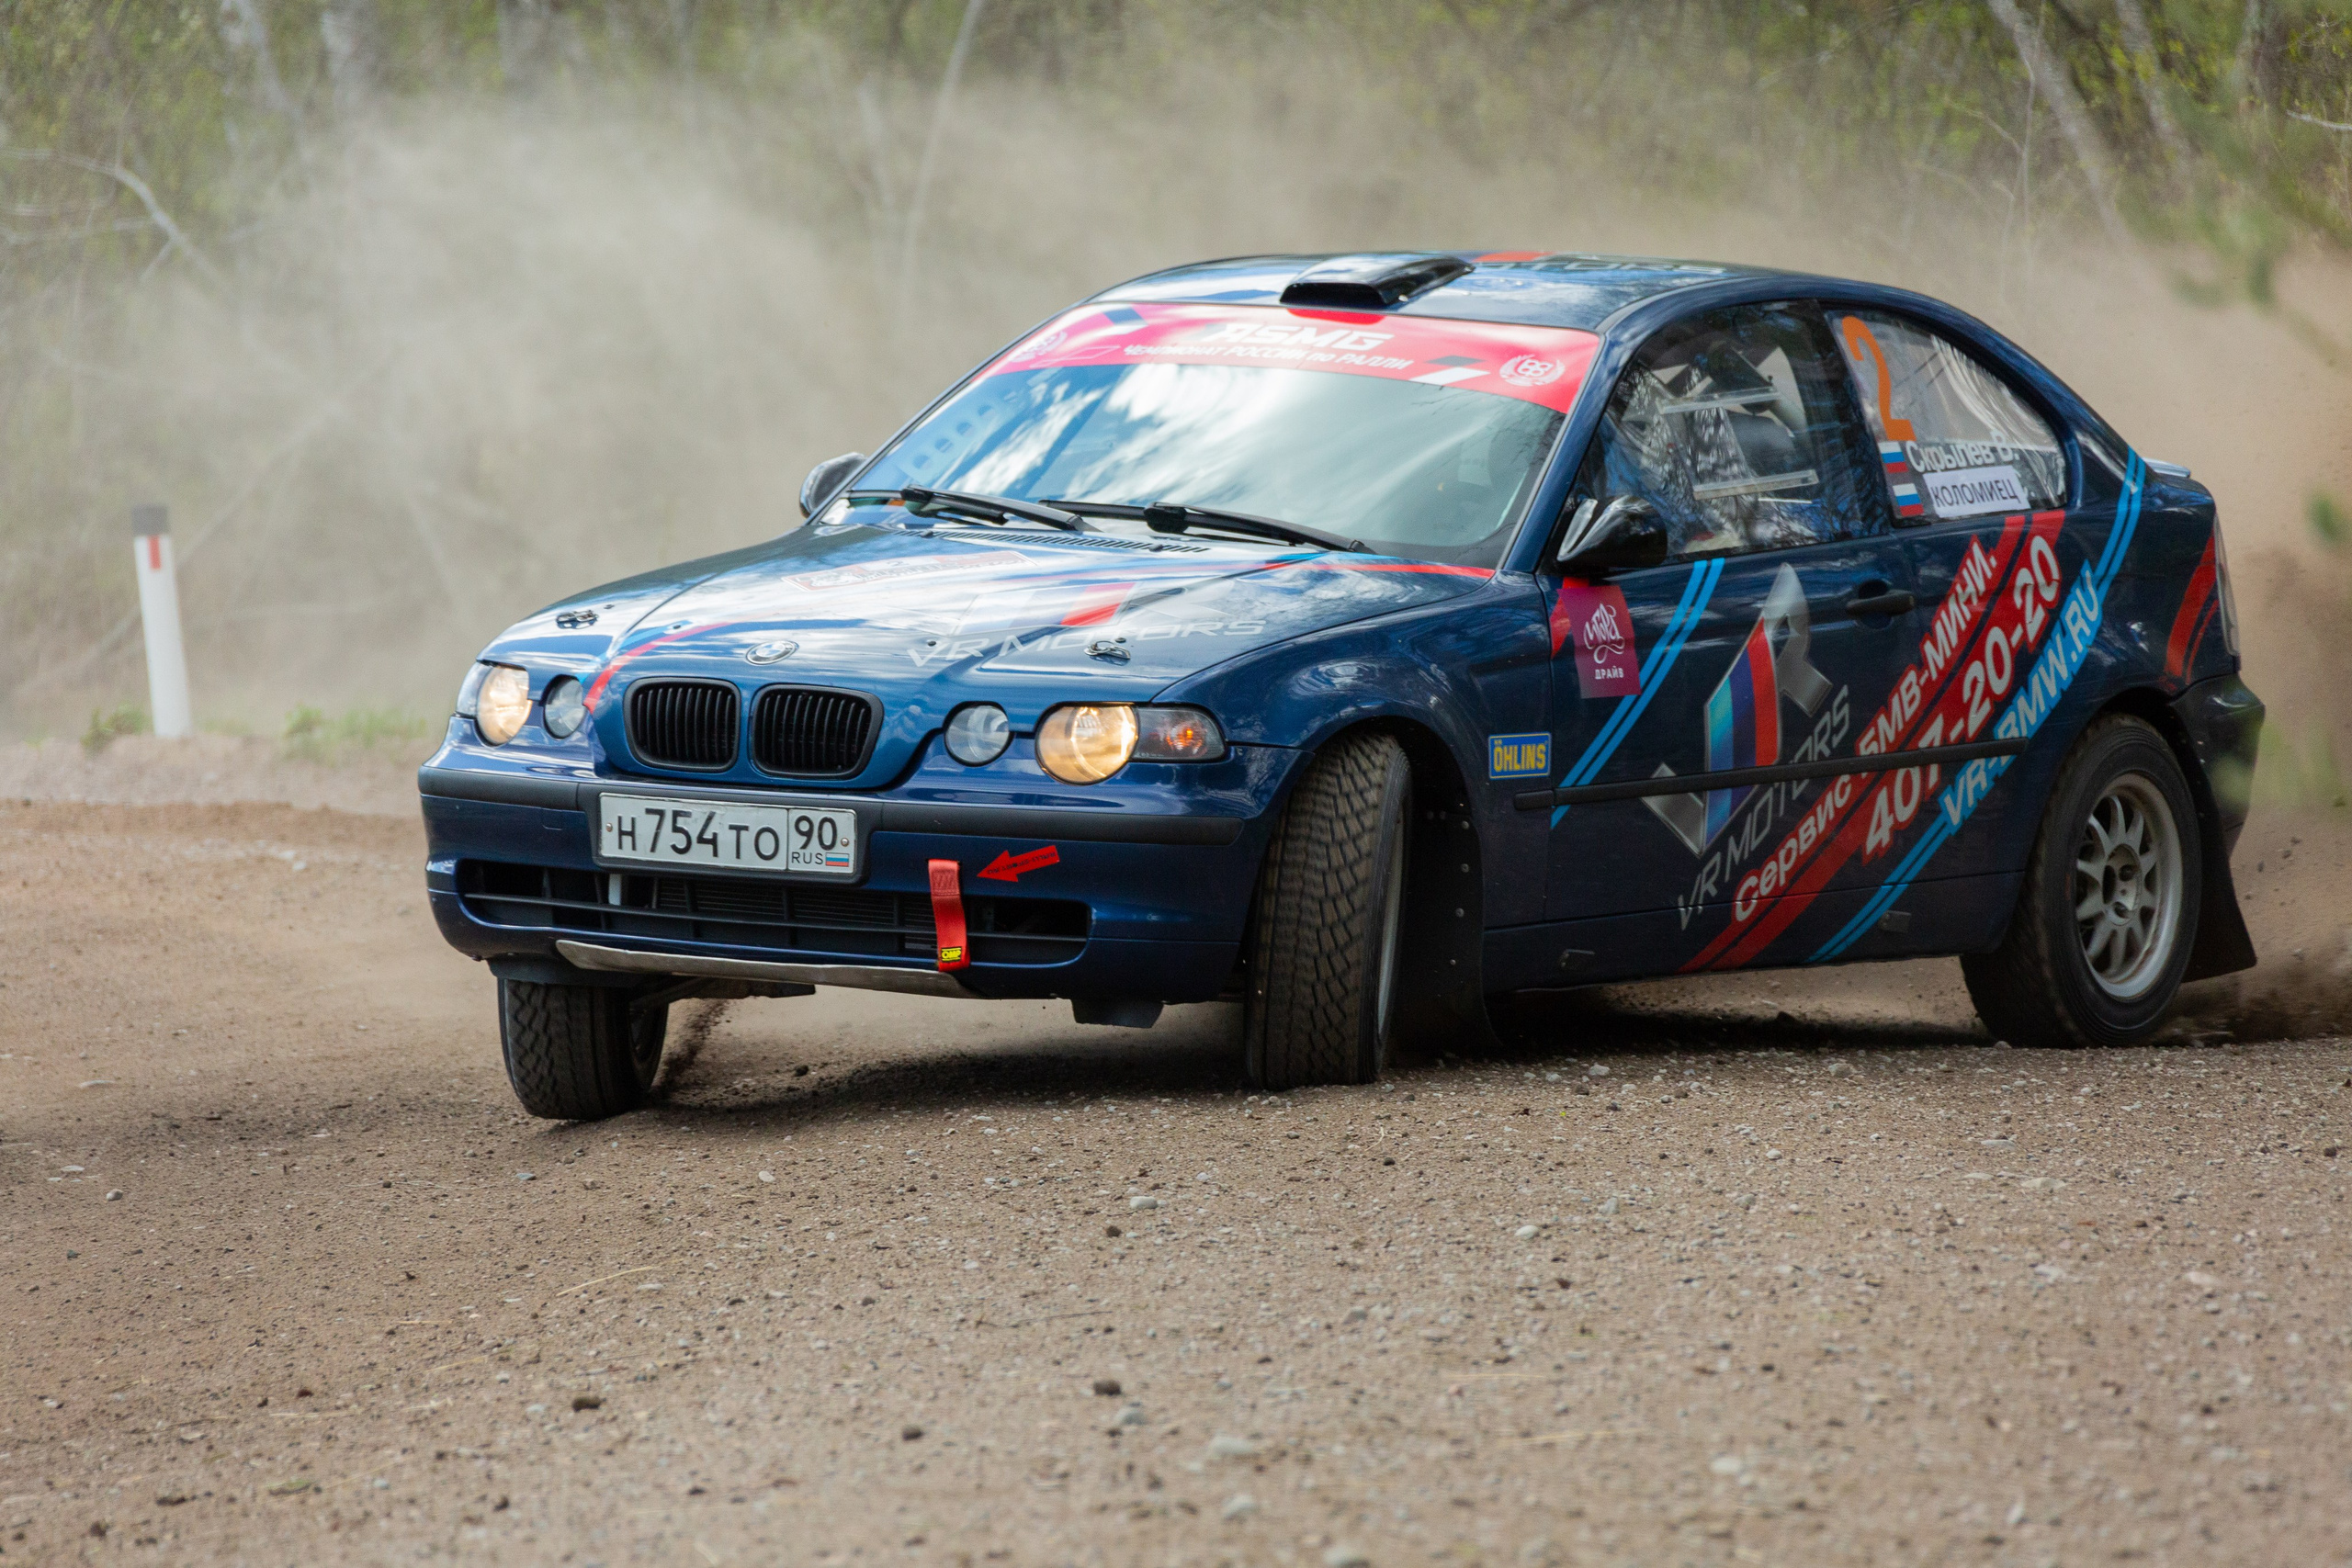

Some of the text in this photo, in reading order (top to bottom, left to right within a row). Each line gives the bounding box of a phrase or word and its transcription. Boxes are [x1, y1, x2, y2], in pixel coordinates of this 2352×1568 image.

[1202, 321, 1396, 352] ASMG
[1226, 345, 1307, 361] РОССИИ
[1338, 353, 1413, 370] РАЛЛИ
[1841, 315, 1917, 441] 2
[1905, 440, 1996, 473] Скрылев
[1930, 479, 2021, 509] КОЛОМИЕЦ
[907, 636, 984, 668] VR
[1594, 665, 1624, 681] ДРАЙВ
[1866, 535, 2061, 856] 407-20-20
[1944, 570, 2099, 826] VR-BMW.RU
[1493, 739, 1547, 773] ÖHLINS
[1678, 684, 1850, 931] VR MOTORS
[794, 815, 838, 851] 90
[1735, 773, 1852, 922] Сервис
[791, 852, 824, 865] RUS
[941, 949, 962, 960] OMP
